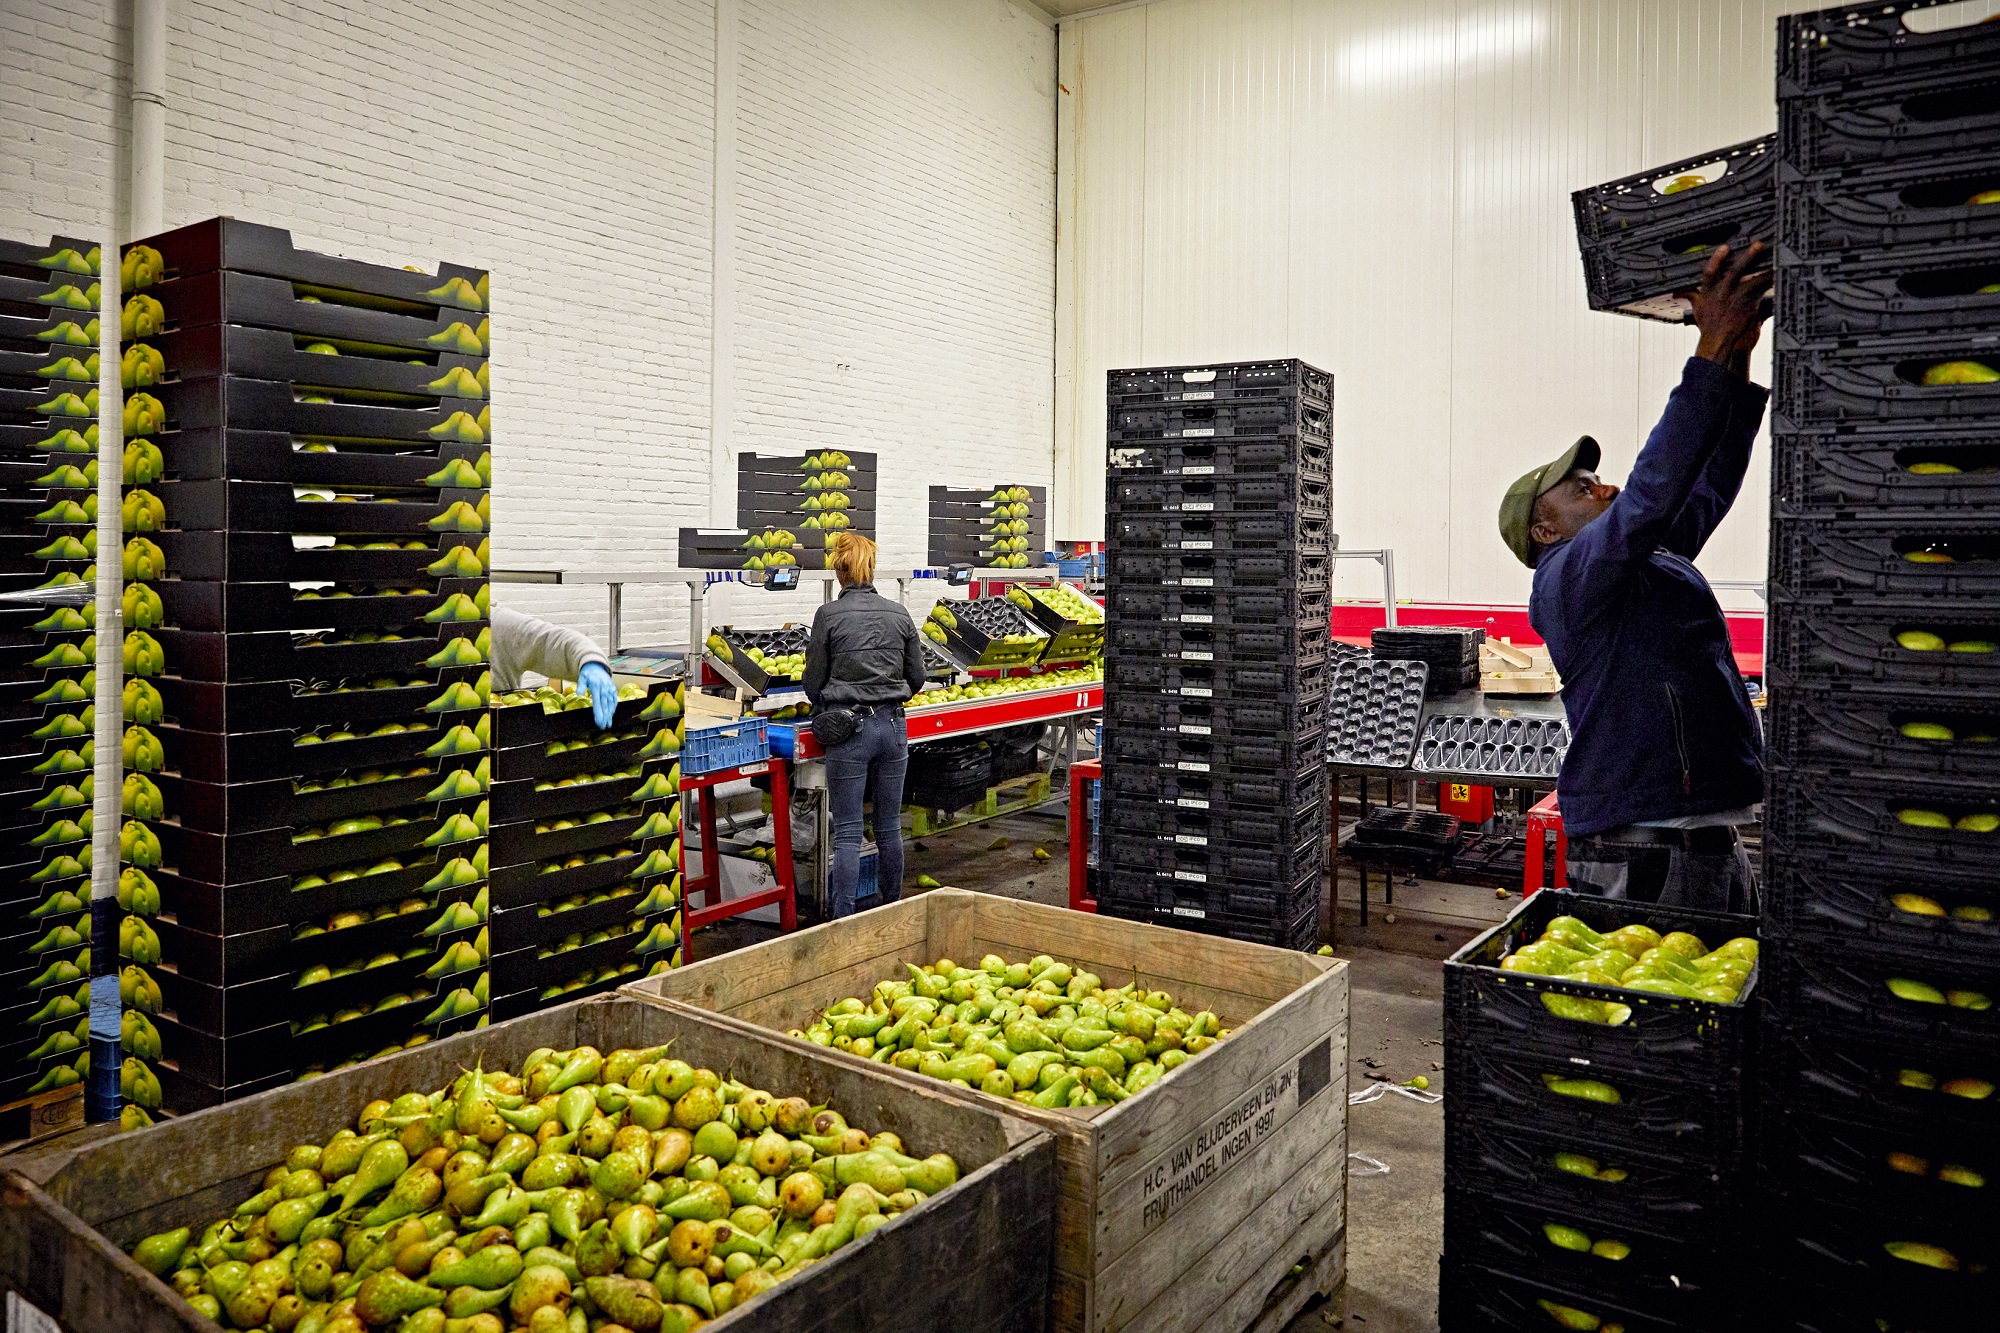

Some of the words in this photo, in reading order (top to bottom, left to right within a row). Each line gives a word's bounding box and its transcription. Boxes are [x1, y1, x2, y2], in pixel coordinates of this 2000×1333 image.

[1143, 1154, 1218, 1227] FRUITHANDEL
[1221, 1126, 1251, 1164] INGEN
[1255, 1108, 1275, 1138] 1997
[1144, 1167, 1166, 1197] H.C.
[1171, 1145, 1192, 1176] VAN
[1196, 1093, 1261, 1157] BLIJDERVEEN
[1265, 1082, 1277, 1104] EN
